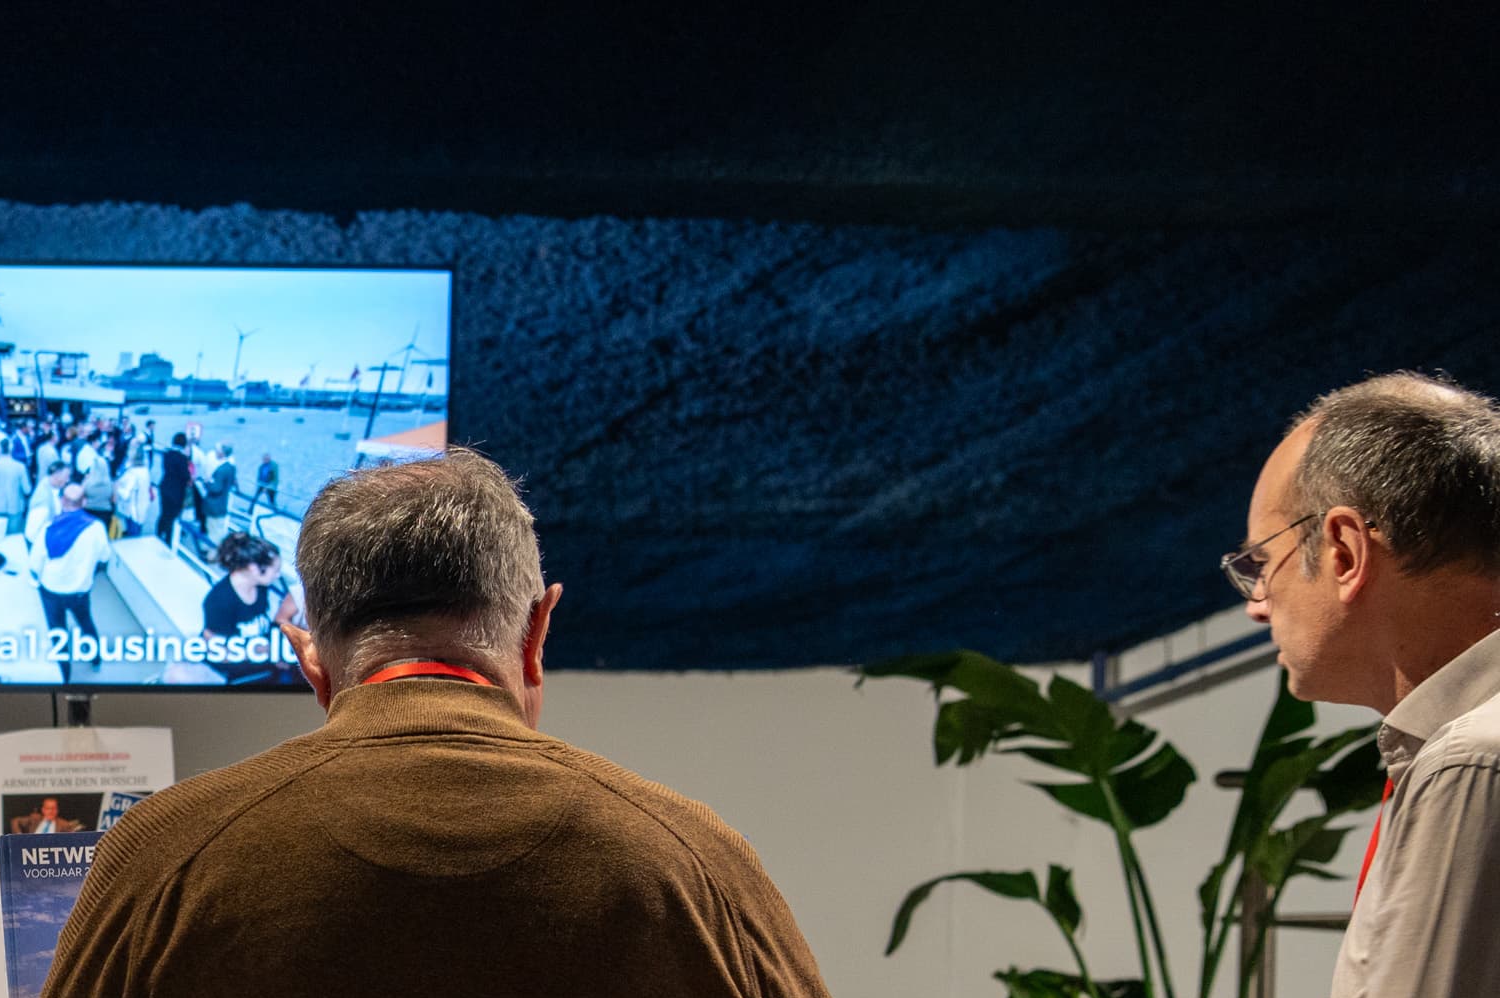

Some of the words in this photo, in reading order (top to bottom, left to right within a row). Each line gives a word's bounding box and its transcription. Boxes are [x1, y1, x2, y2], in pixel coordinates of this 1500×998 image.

[50, 778, 72, 787] VAN
[75, 777, 98, 786] DEN
[21, 845, 96, 866] NETWE
[23, 867, 83, 878] VOORJAAR
